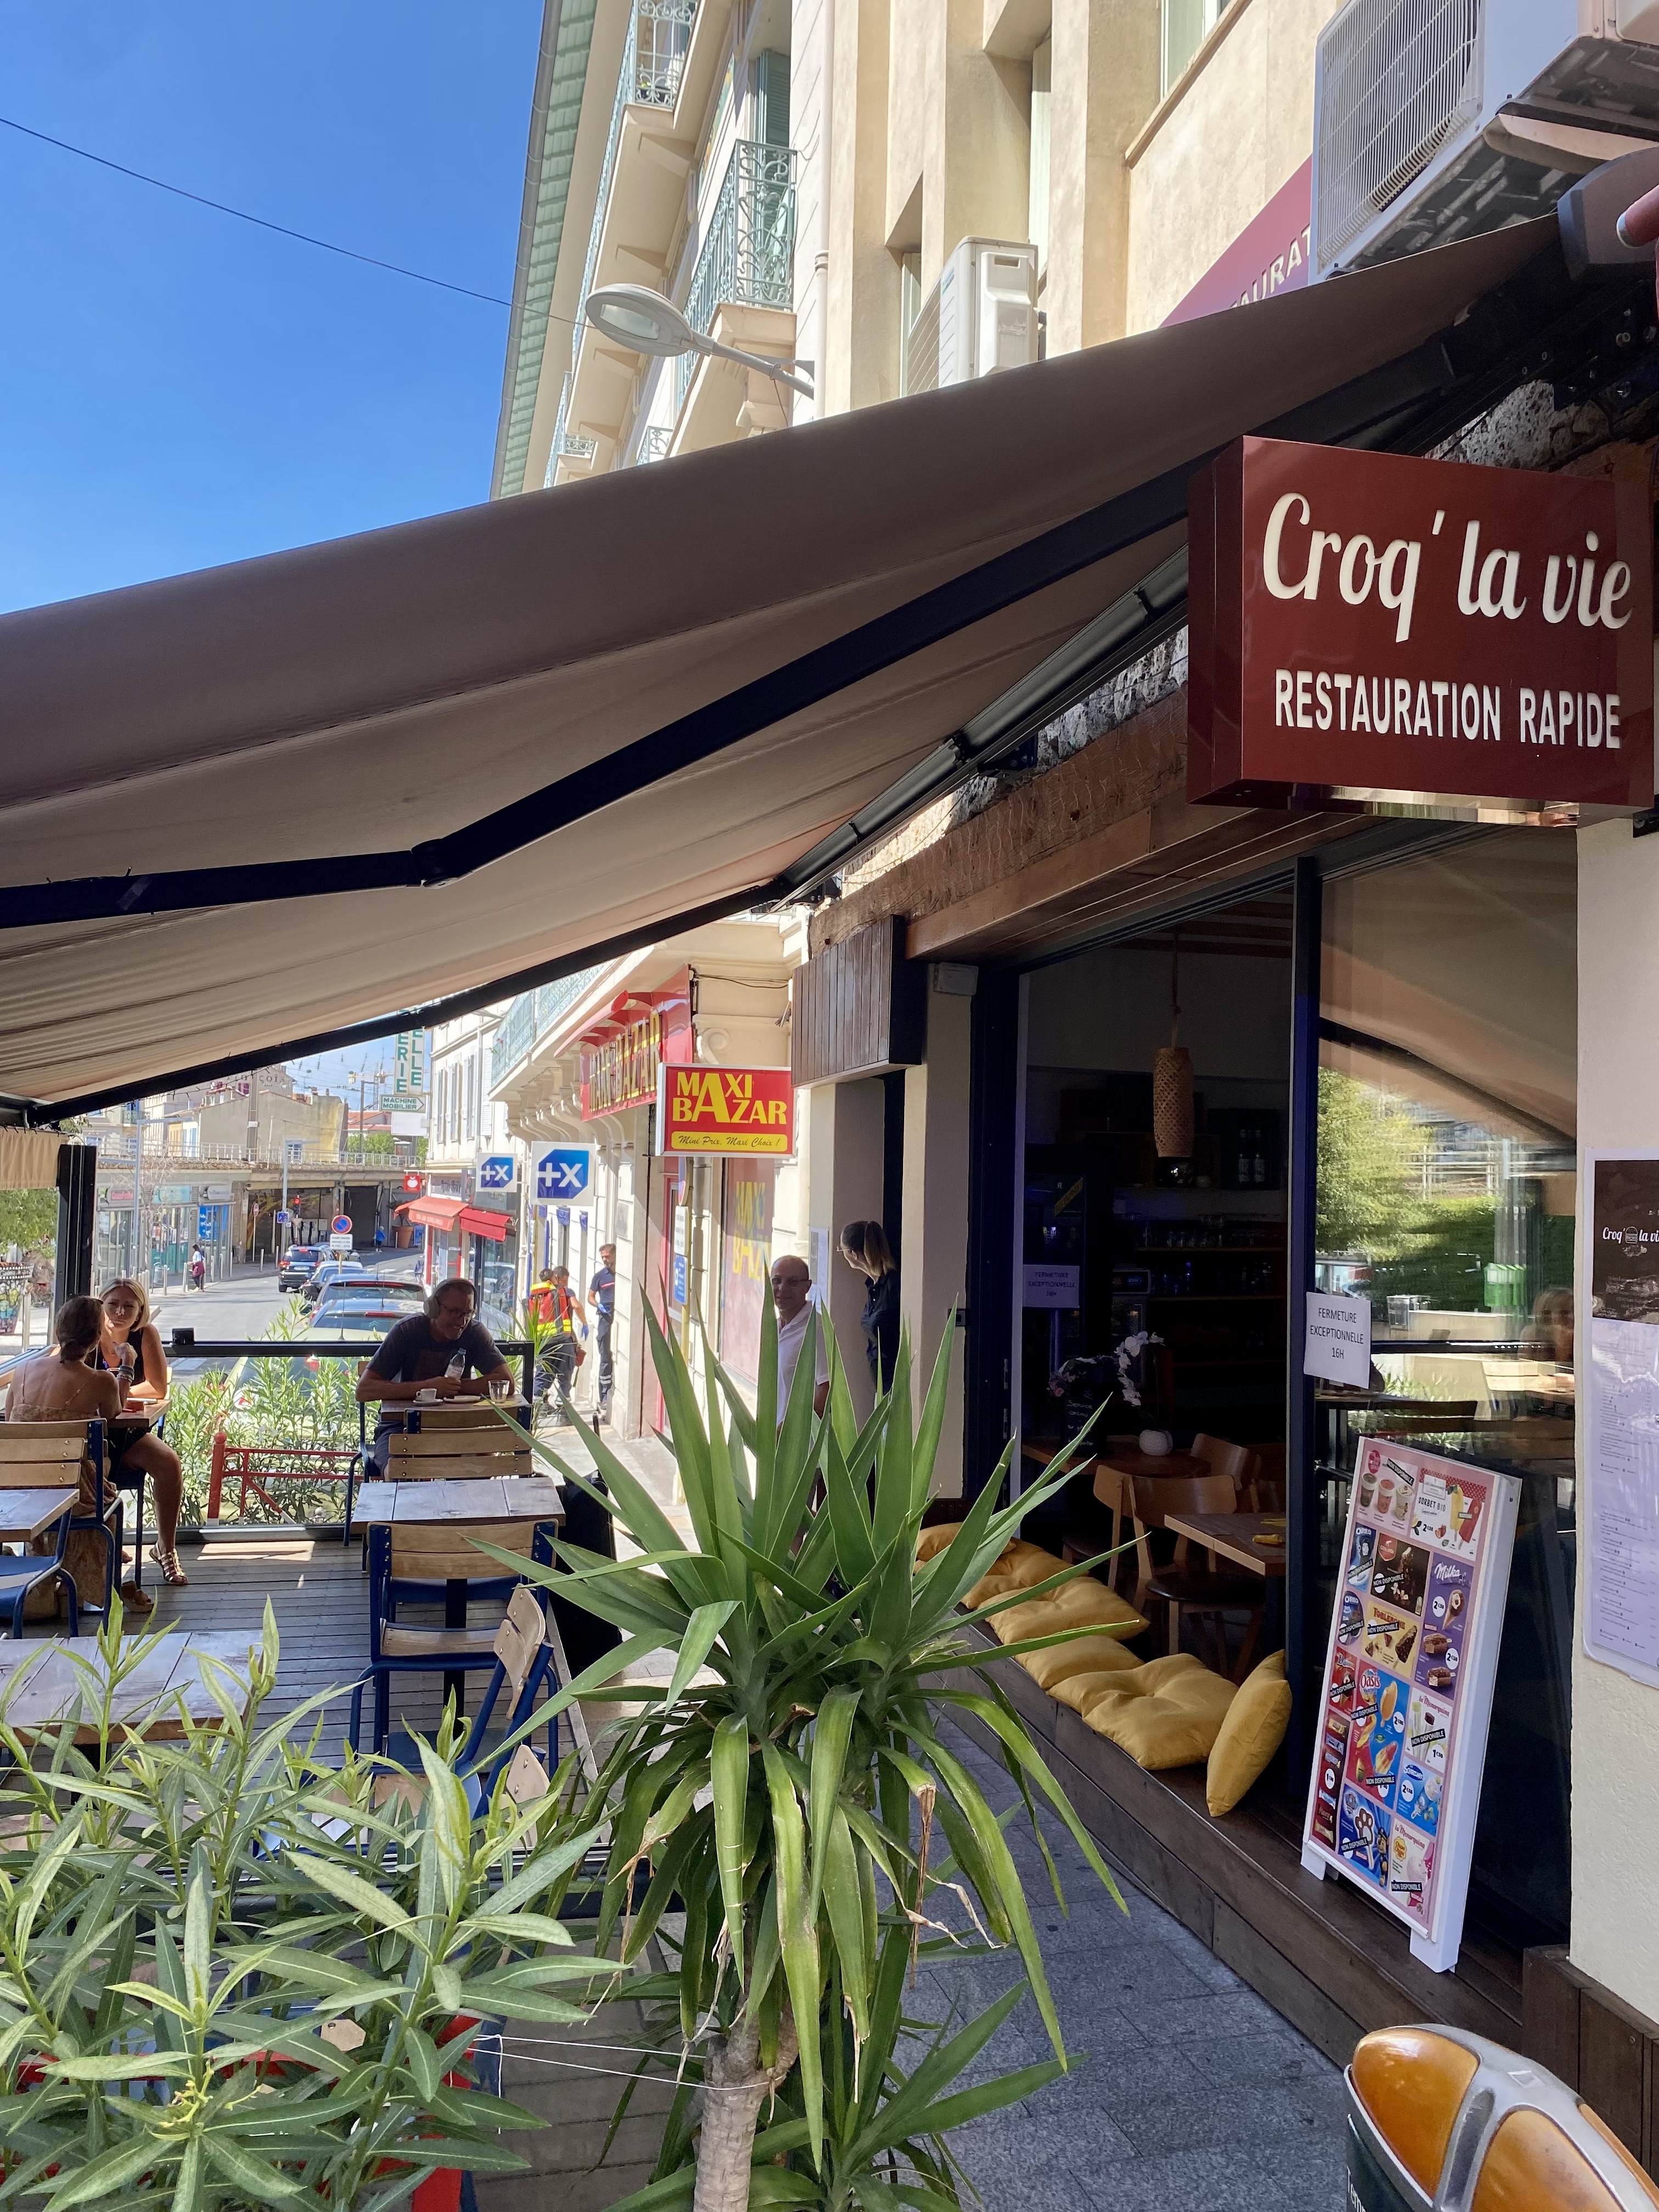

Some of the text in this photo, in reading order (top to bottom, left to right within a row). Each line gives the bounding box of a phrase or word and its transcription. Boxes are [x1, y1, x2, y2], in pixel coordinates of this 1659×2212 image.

[1263, 492, 1632, 642] Croq' la vie
[1276, 669, 1621, 749] RESTAURATION RAPIDE
[677, 1071, 753, 1099] MAXI
[672, 1096, 787, 1125] BAZAR
[678, 1135, 700, 1144] Mini
[726, 1136, 748, 1146] Maxi
[751, 1137, 772, 1147] Choix
[1639, 1229, 1649, 1242] la
[1318, 1307, 1357, 1323] FERMETURE
[1310, 1324, 1364, 1344] EXCEPTIONNELLE
[1331, 1347, 1344, 1359] 16H
[1418, 1497, 1446, 1512] SORBET BIO
[1382, 1573, 1404, 1584] DISPONIBLE
[1434, 1562, 1460, 1581] Milka
[1376, 1622, 1398, 1632] DISPONIBLE
[1336, 1681, 1355, 1694] DISPONIBLE
[1360, 1672, 1380, 1688] Oasis
[1359, 1705, 1378, 1716] DISPONIBLE
[1420, 1730, 1444, 1743] DISPONIBLE
